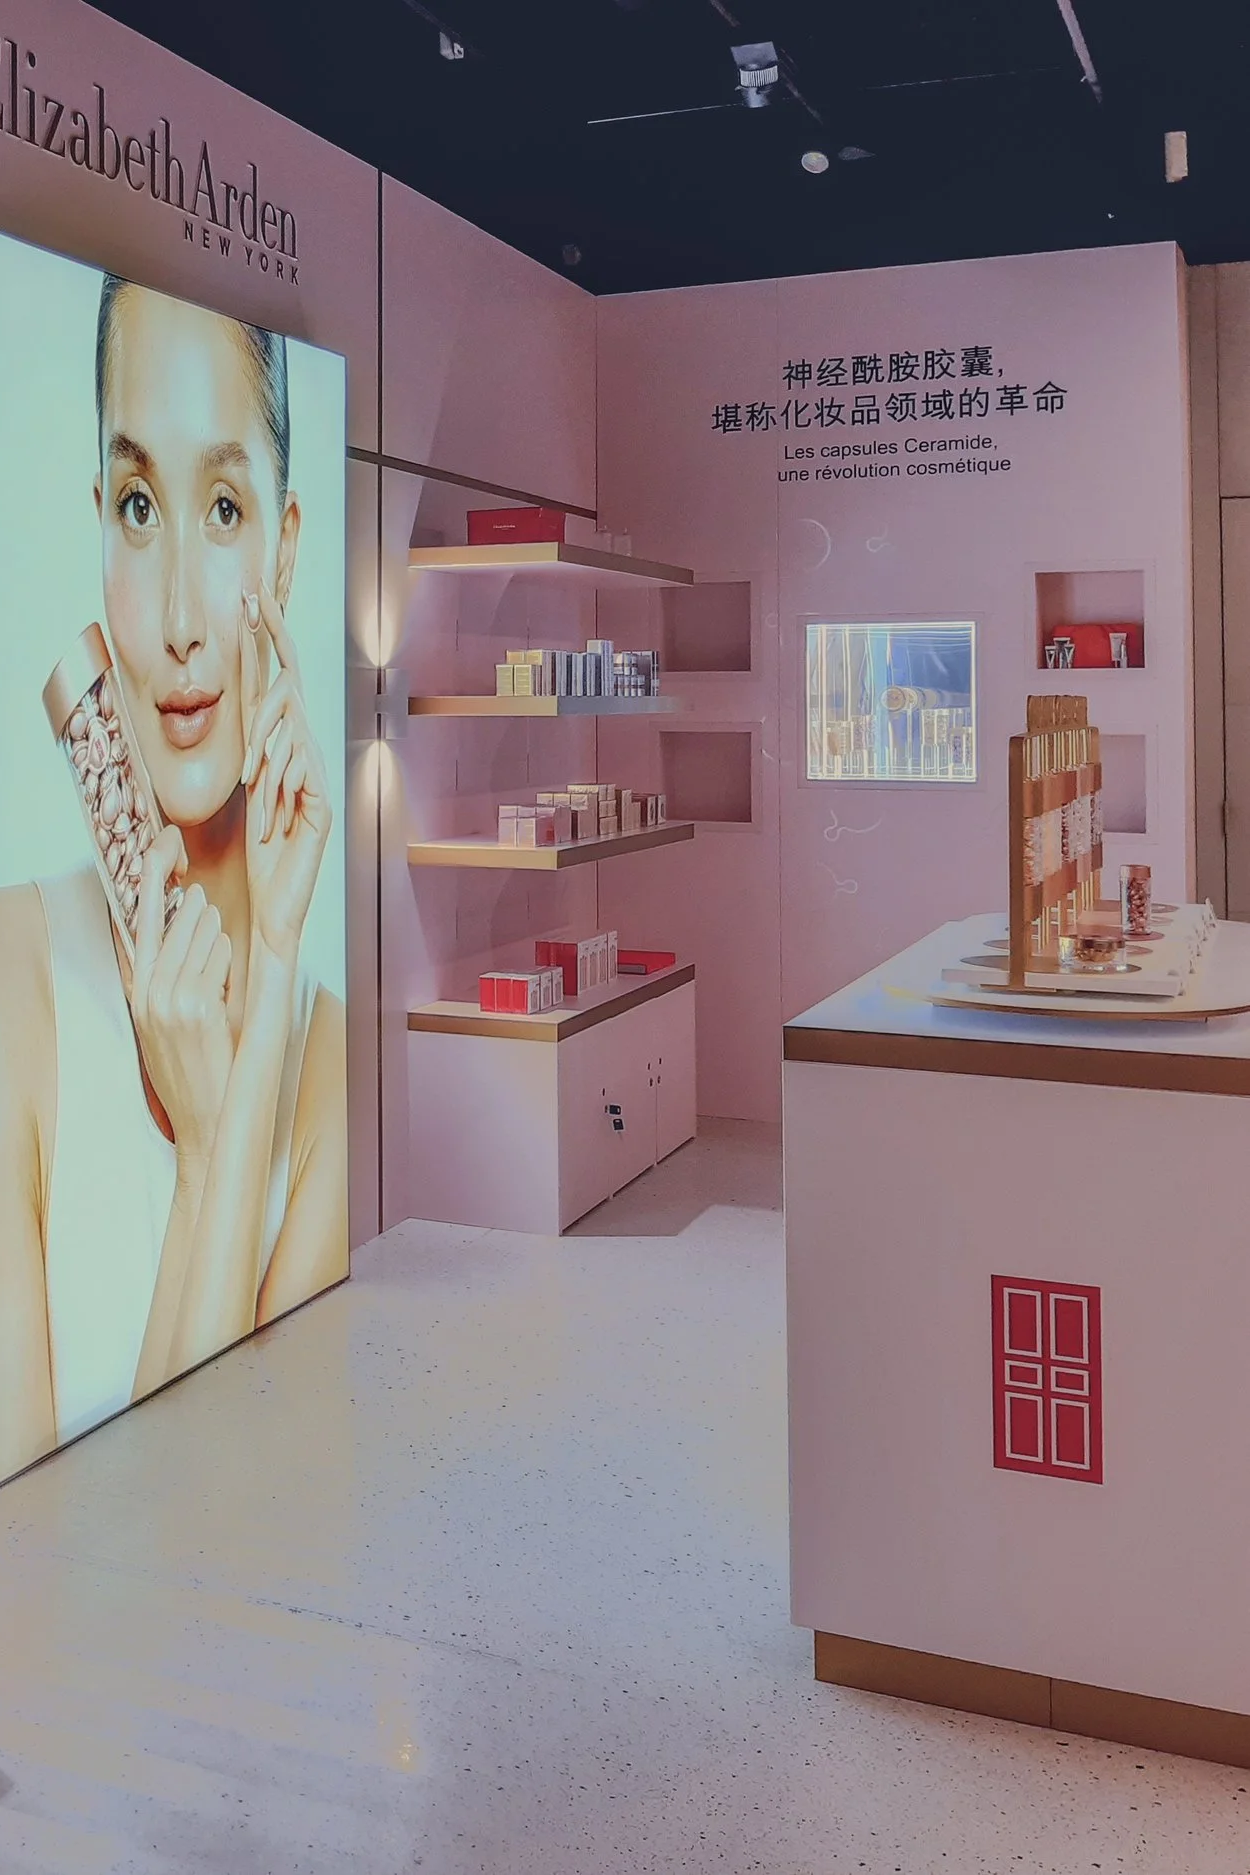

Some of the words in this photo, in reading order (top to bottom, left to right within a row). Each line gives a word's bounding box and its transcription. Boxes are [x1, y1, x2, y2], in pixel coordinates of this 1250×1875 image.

[183, 219, 232, 257] NEW
[245, 248, 300, 286] YORK
[711, 380, 1069, 434] 堪称化妆品领域的革命
[784, 445, 815, 460] Les
[820, 439, 898, 461] capsules
[904, 435, 998, 454] Ceramide,
[777, 467, 810, 482] une
[815, 460, 900, 481] révolution
[906, 456, 1012, 477] cosmétique
